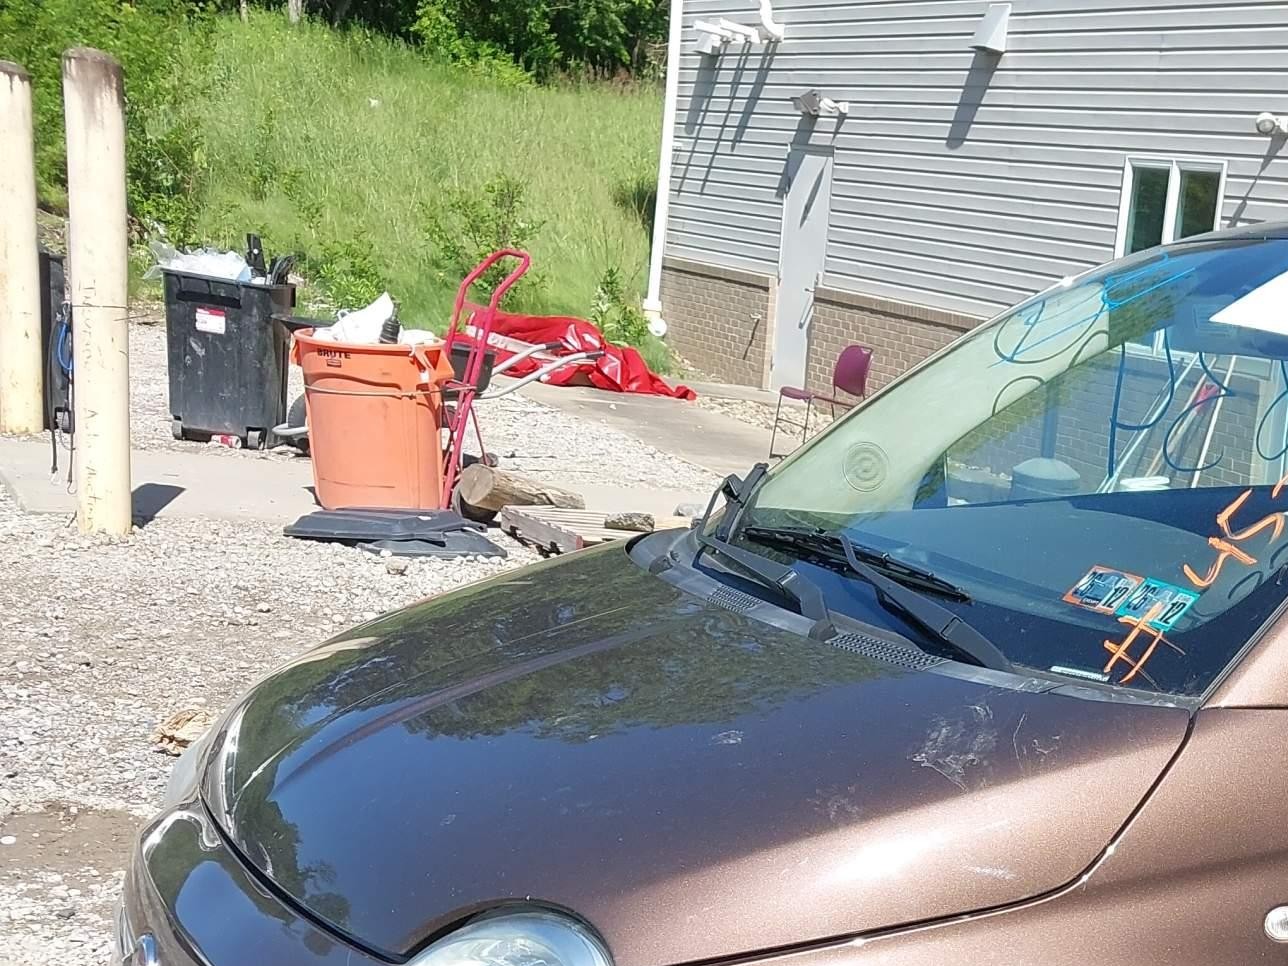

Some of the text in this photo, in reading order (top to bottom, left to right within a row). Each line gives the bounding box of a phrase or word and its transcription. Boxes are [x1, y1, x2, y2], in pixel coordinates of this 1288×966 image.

[317, 348, 351, 359] BRUTE
[1102, 586, 1129, 609] 12
[1126, 584, 1188, 625] 26 12
